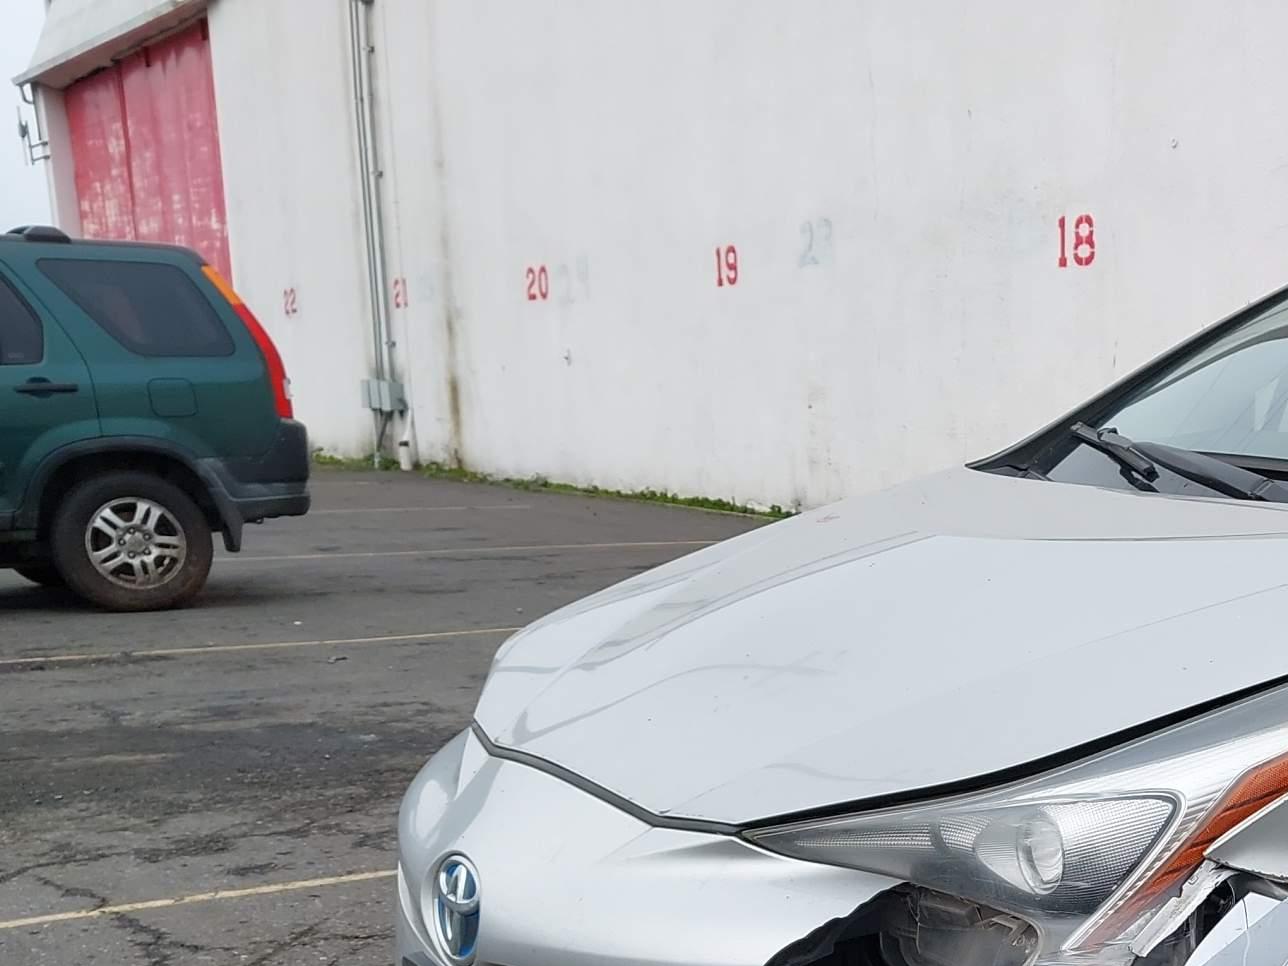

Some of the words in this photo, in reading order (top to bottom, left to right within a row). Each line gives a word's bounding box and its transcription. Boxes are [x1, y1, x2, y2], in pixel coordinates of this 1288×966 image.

[1057, 213, 1097, 269] 18
[525, 264, 550, 302] 20
[715, 244, 740, 288] 19
[283, 287, 298, 315] 22
[393, 278, 409, 309] 21
